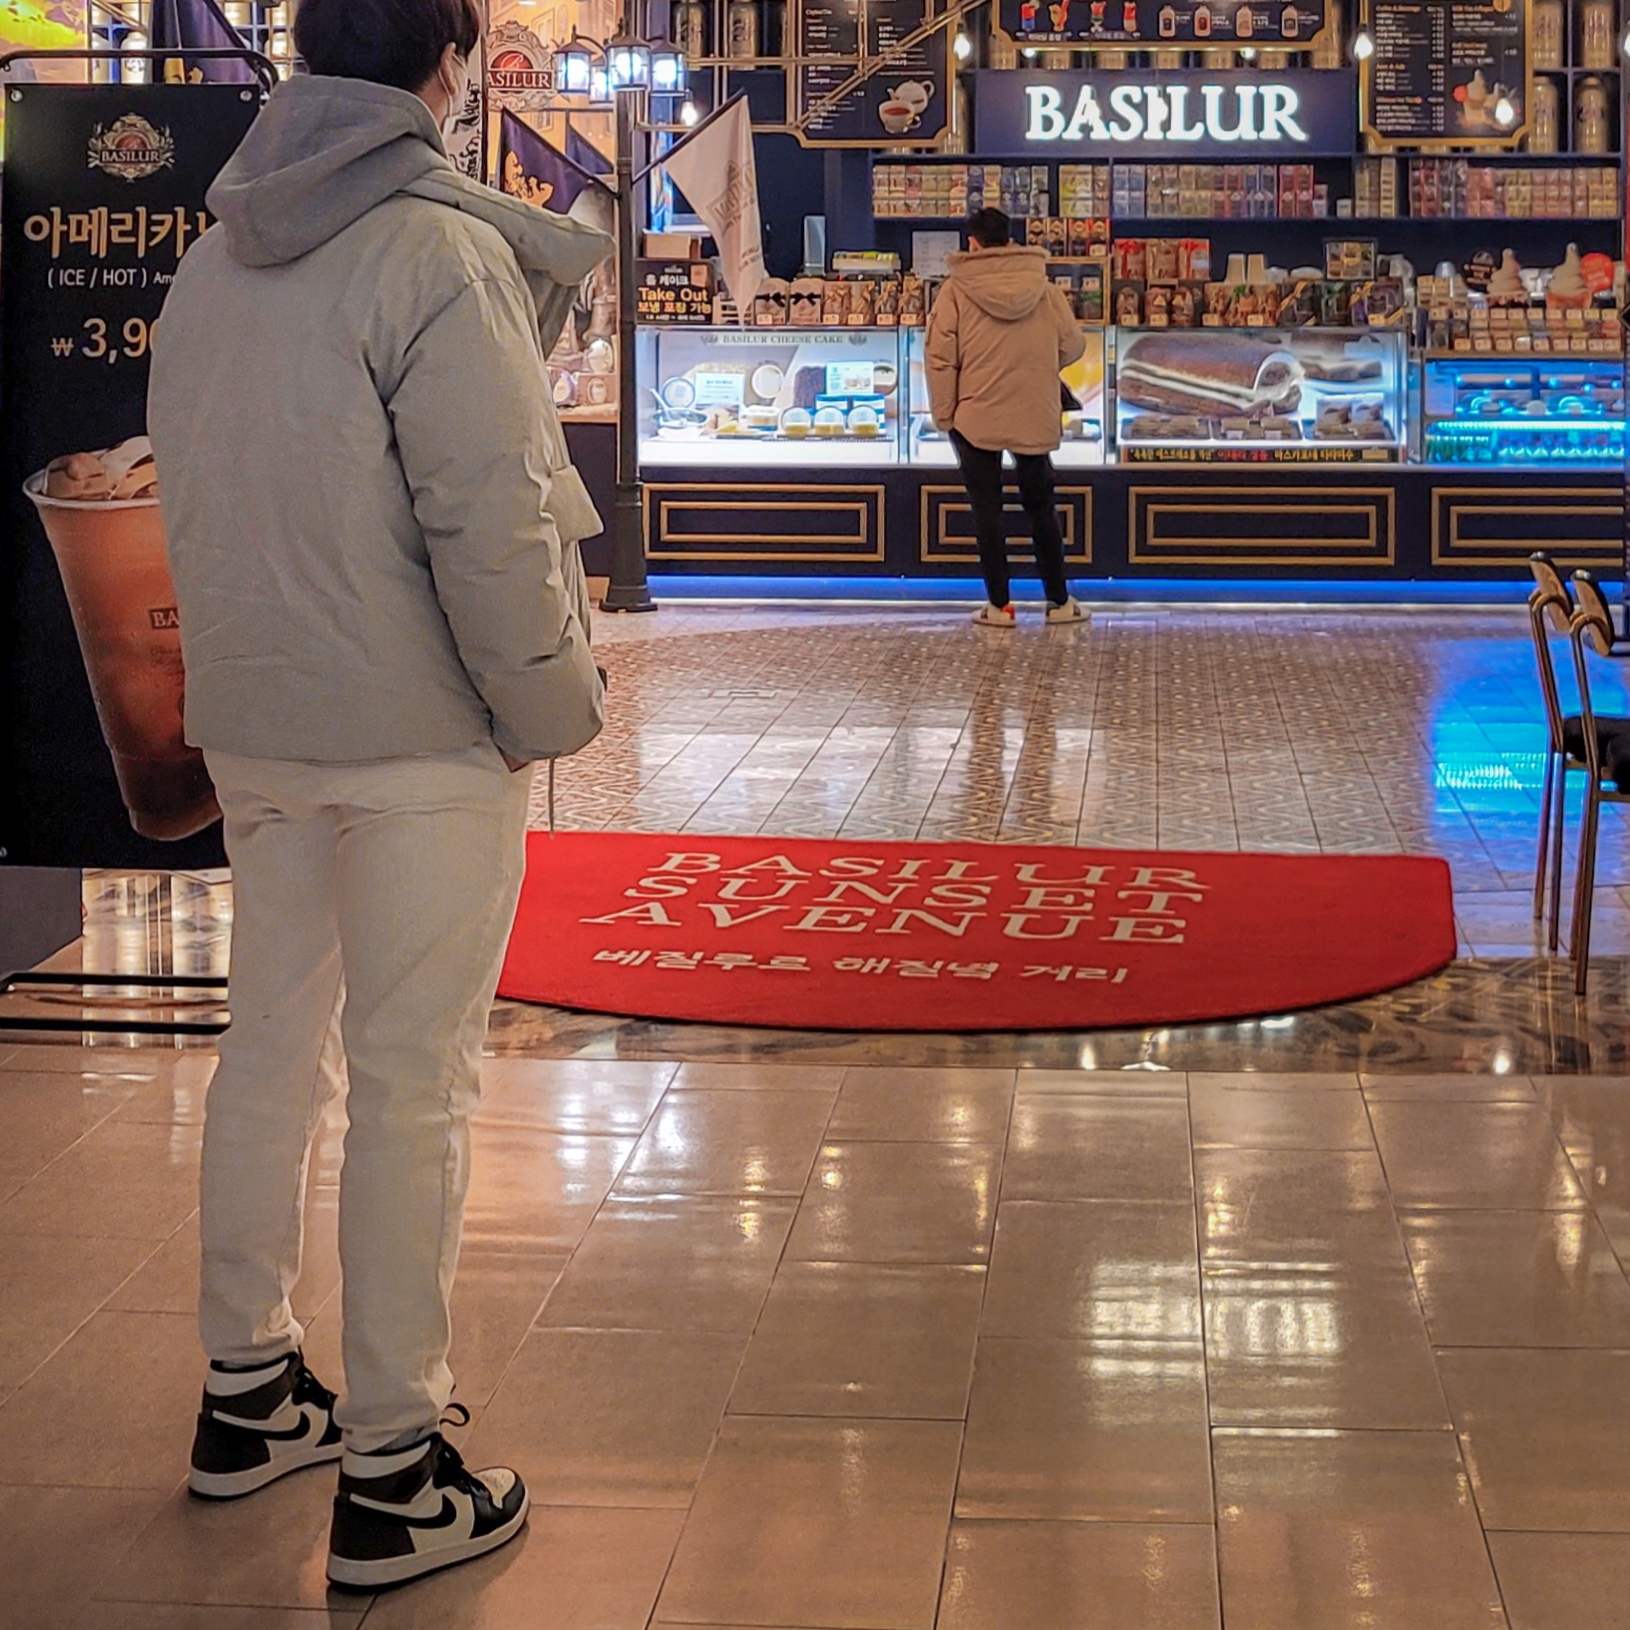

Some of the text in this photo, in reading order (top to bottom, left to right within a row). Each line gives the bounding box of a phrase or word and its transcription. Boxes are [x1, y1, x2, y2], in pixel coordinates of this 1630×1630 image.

[488, 72, 551, 88] ASILUR
[1025, 84, 1310, 141] BASILUR
[101, 151, 160, 162] BASILUR
[637, 287, 708, 302] Take Out
[82, 317, 160, 364] 3,9
[722, 335, 844, 344] BASILUR CHEESE CAKE
[647, 852, 1212, 889] BASILUR
[624, 876, 1203, 914] SUNSET
[578, 902, 1187, 943] AVENUE
[1020, 965, 1128, 984] 거리
